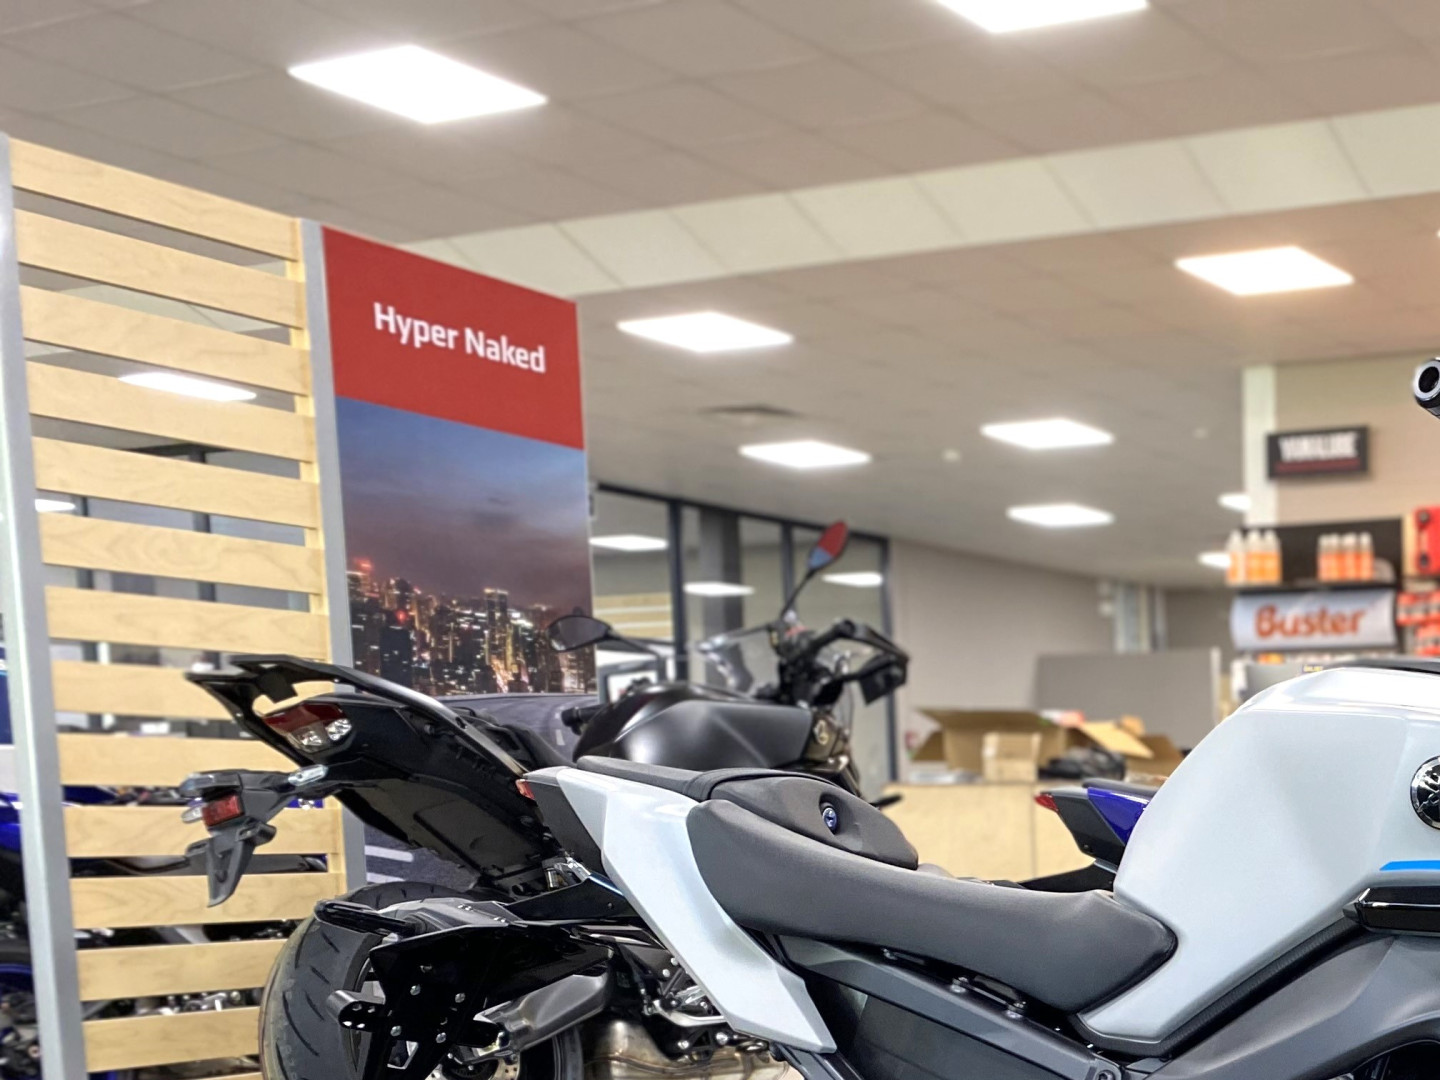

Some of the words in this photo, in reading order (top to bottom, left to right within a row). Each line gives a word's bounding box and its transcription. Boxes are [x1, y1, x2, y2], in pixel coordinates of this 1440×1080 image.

[373, 301, 460, 350] Hyper
[464, 326, 547, 374] Naked
[1254, 604, 1366, 641] Buster
